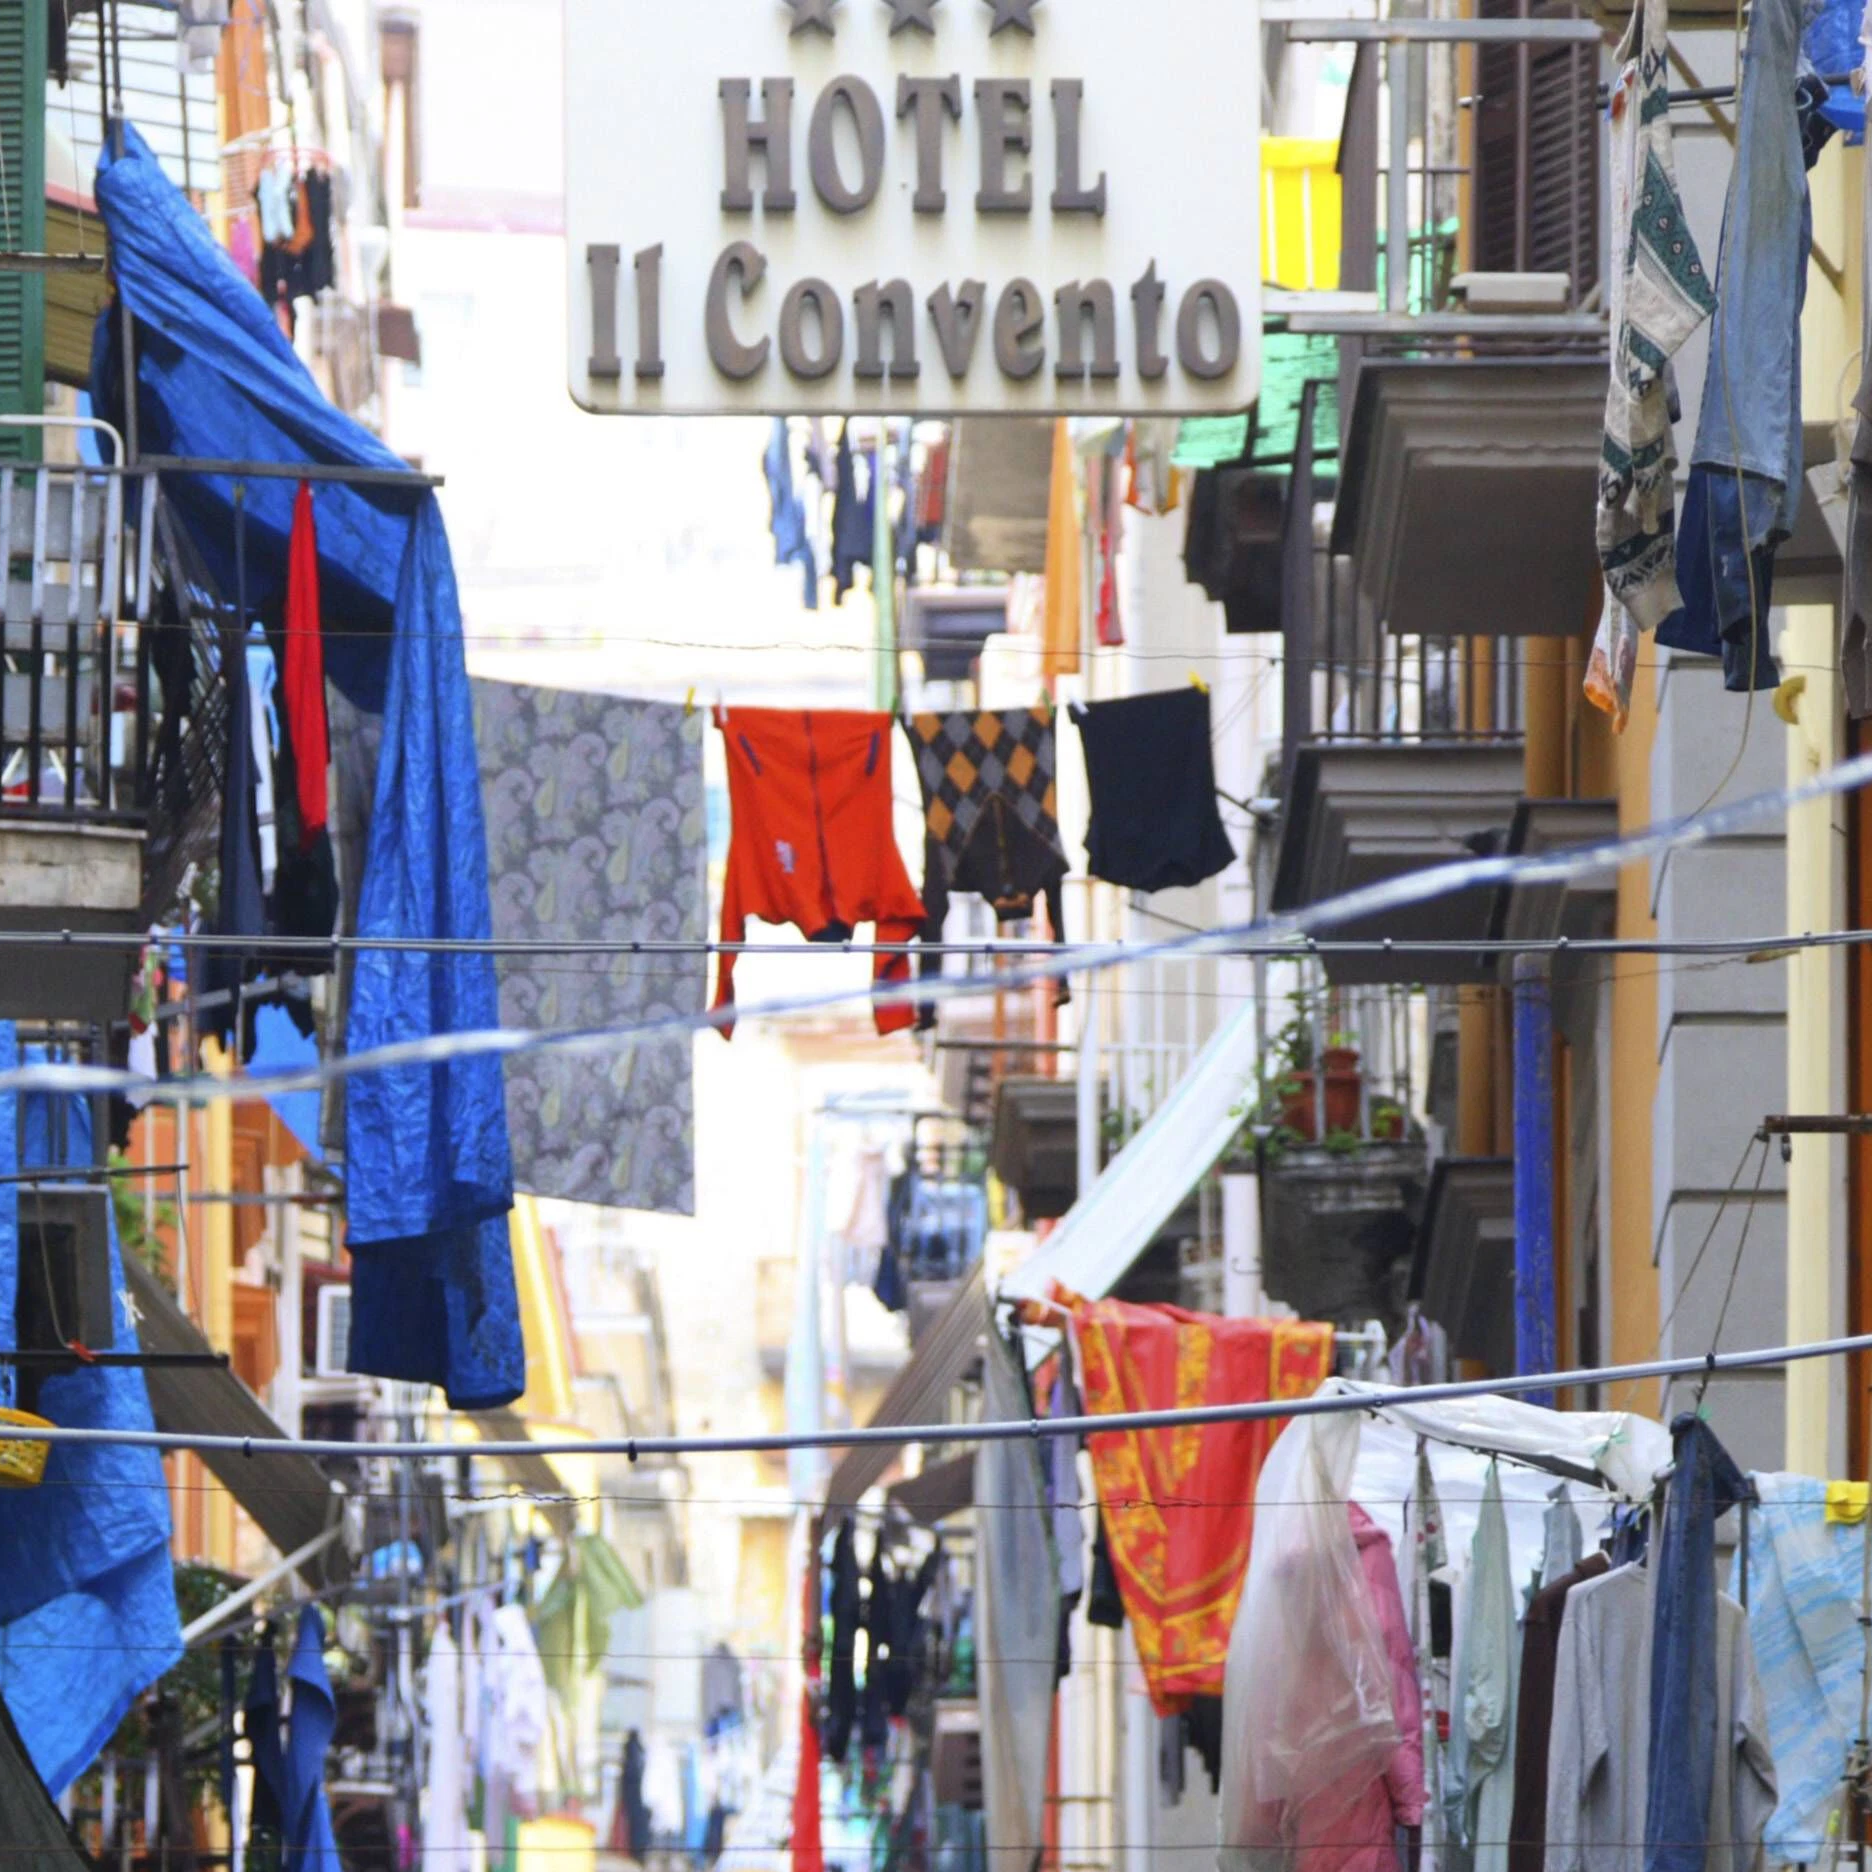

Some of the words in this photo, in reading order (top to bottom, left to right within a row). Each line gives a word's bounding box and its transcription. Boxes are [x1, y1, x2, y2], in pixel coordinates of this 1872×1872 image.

[718, 74, 1106, 217] HOTEL
[586, 243, 665, 379] Il
[704, 240, 1241, 381] Convento
